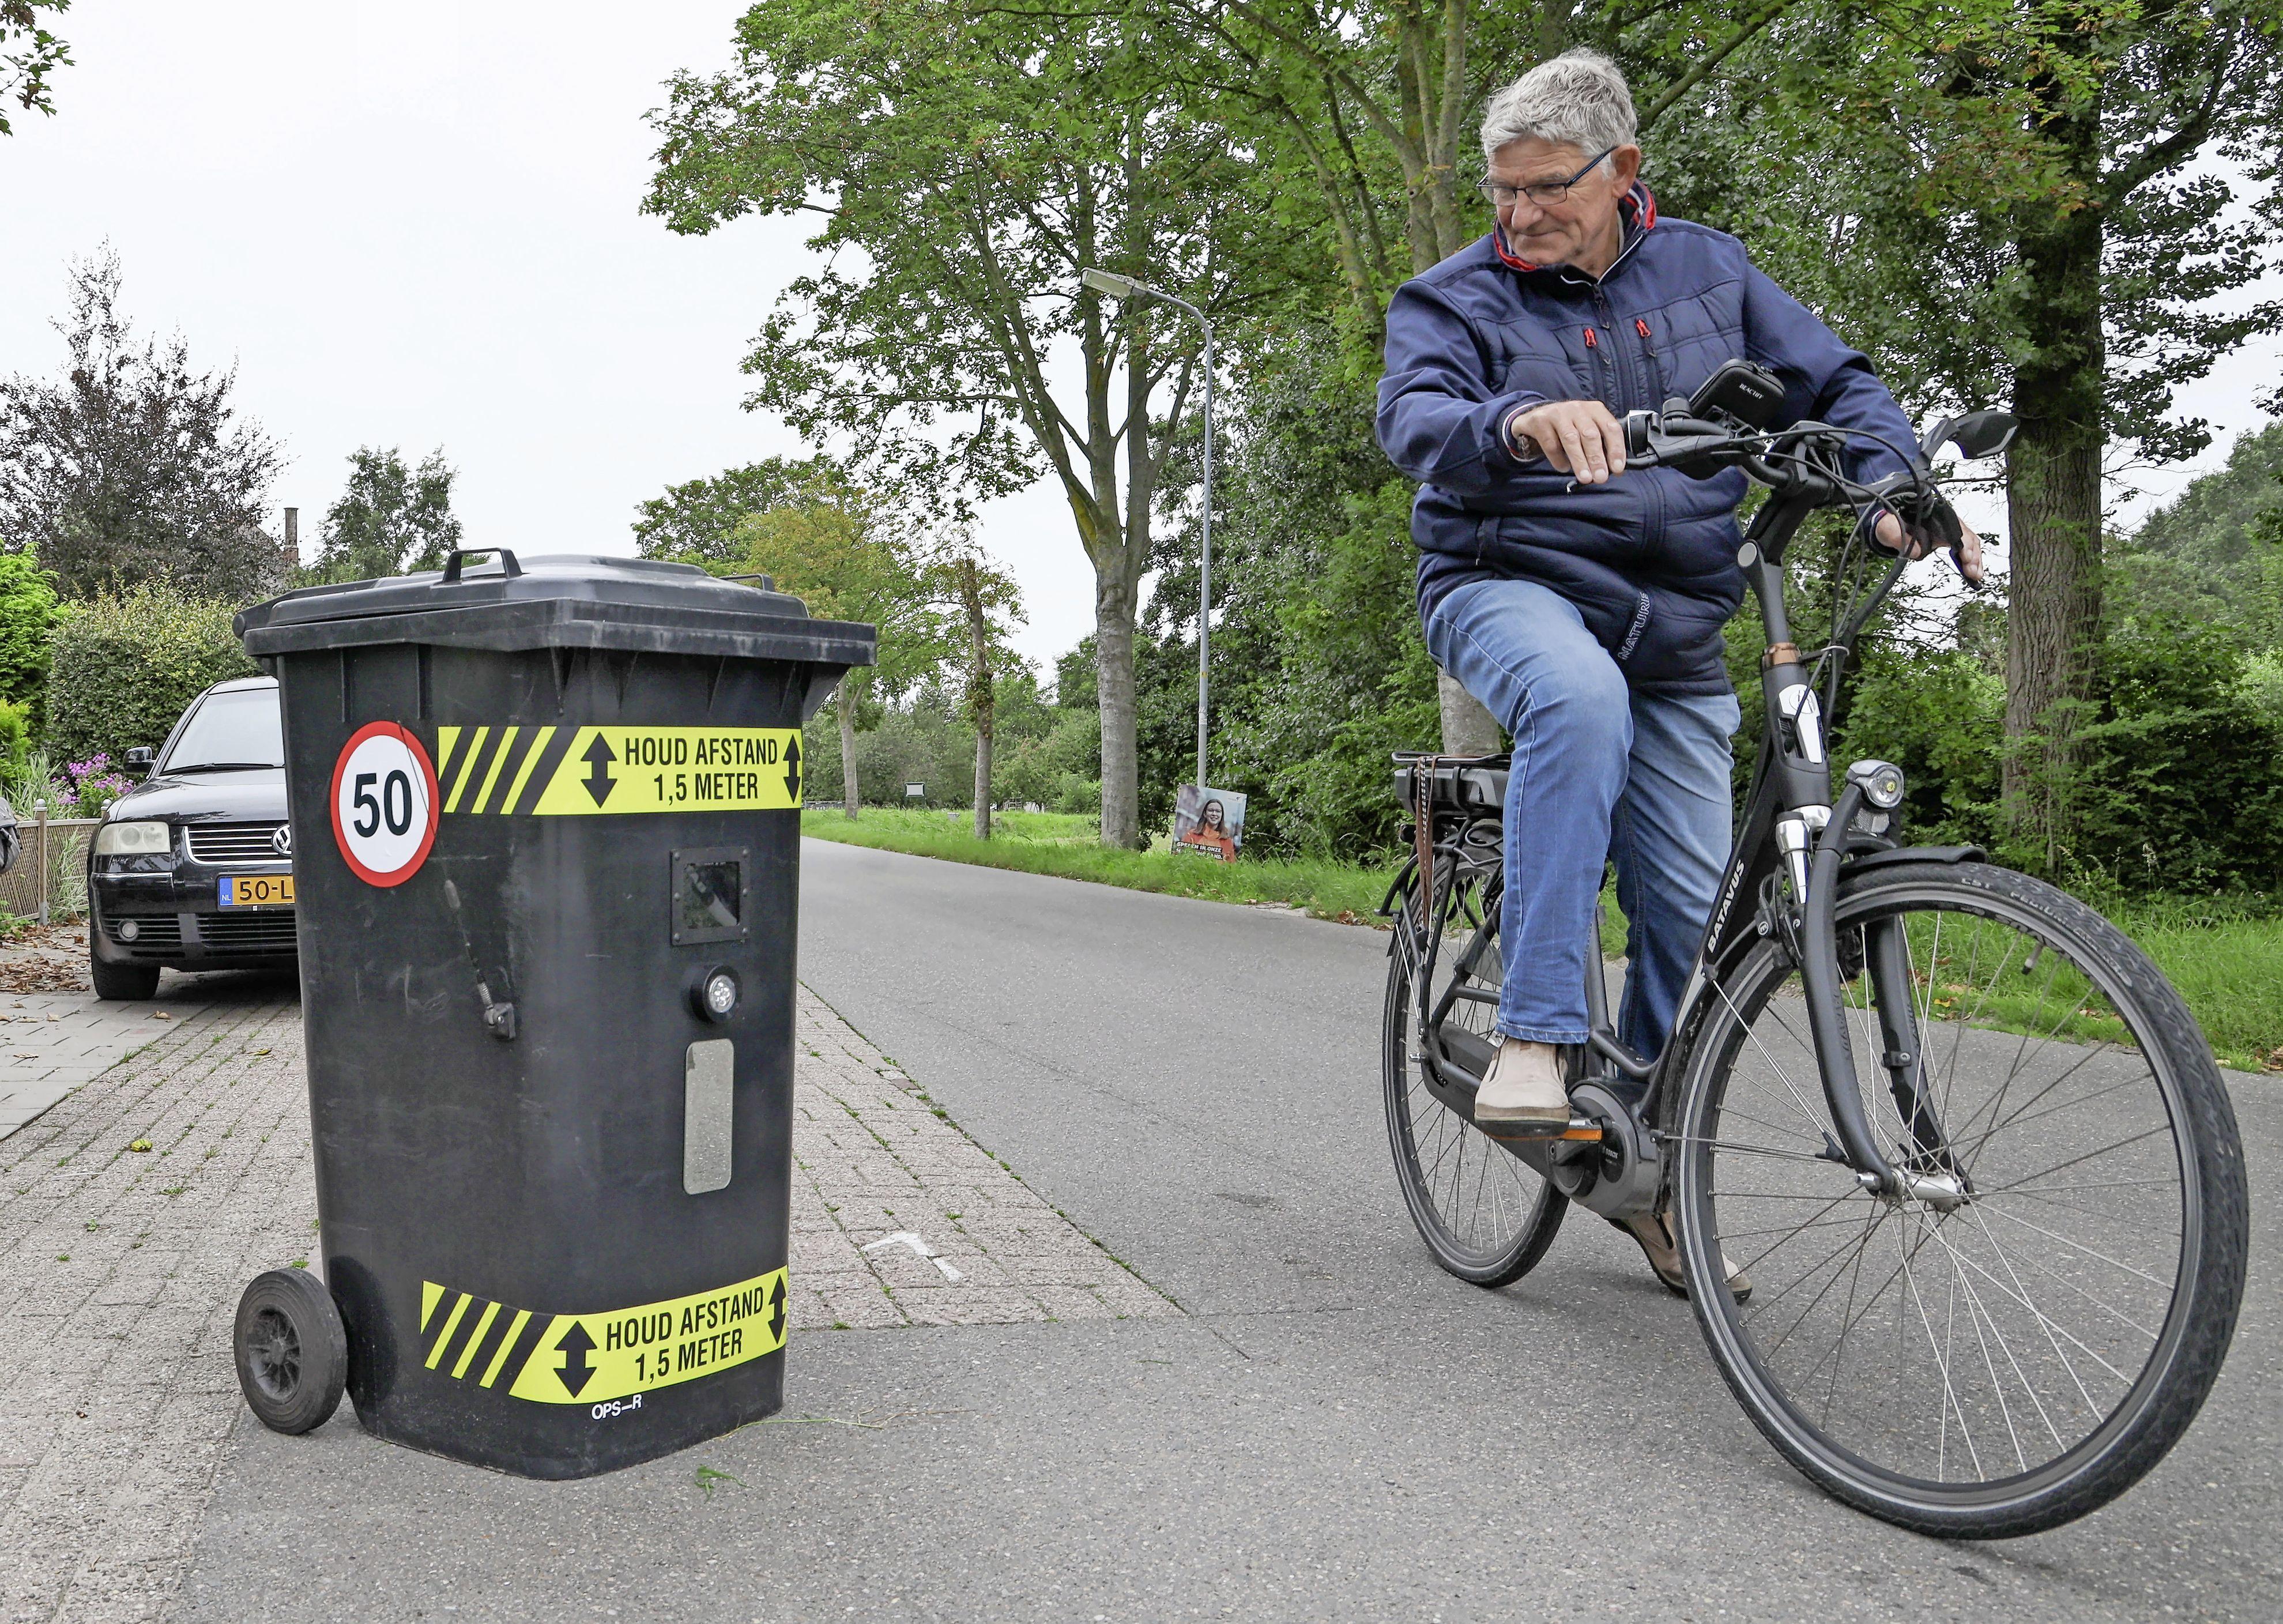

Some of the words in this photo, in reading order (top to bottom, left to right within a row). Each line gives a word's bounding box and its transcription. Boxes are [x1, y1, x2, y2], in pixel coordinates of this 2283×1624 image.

[625, 737, 688, 766] HOUD
[695, 737, 778, 766] AFSTAND
[353, 769, 412, 838] 50
[654, 773, 687, 806] 1,5
[695, 773, 759, 800] METER
[1707, 858, 1745, 954] BATAVUS
[606, 1312, 672, 1351] HOUD
[679, 1286, 764, 1336] AFSTAND
[635, 1348, 670, 1384] 1,5
[677, 1328, 743, 1373] METER
[590, 1393, 643, 1421] OPS-R
